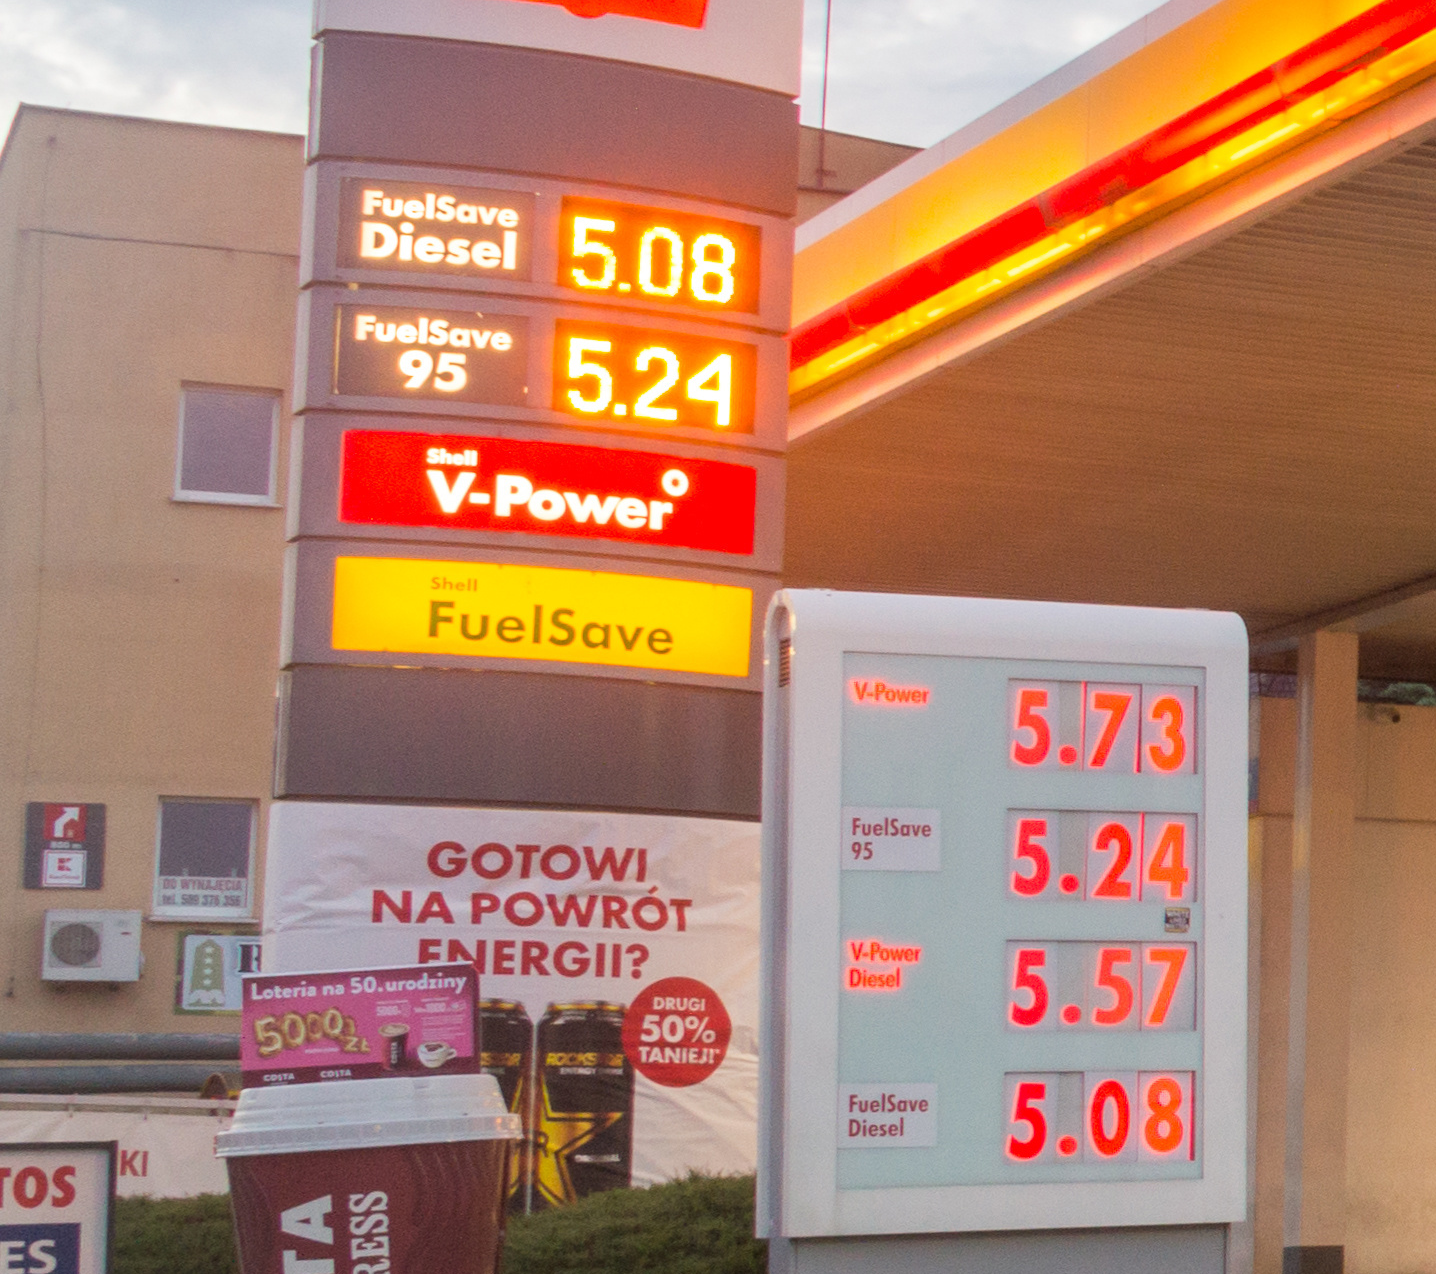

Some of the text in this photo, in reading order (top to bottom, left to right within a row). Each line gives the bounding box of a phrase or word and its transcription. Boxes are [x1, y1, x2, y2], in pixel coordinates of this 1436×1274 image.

[361, 188, 519, 229] FuelSave
[359, 222, 517, 270] Diesel
[570, 216, 736, 304] 5.08
[354, 314, 513, 353] FuelSave
[398, 351, 467, 393] 95
[567, 336, 733, 426] 5.24
[426, 447, 478, 467] Shell
[426, 469, 674, 531] V-Power
[430, 576, 479, 594] Shell
[428, 600, 674, 655] FuelSave
[851, 680, 930, 706] V-Power
[1010, 689, 1187, 772] 5.73
[851, 816, 931, 839] FuelSave
[427, 840, 647, 883] GOTOWI
[851, 841, 873, 861] 95
[1011, 819, 1189, 899] 5.24
[371, 886, 692, 933] NA POWRÓT
[418, 938, 650, 980] ENERGII?
[850, 942, 922, 964] V-Power
[251, 981, 317, 1000] Loteria
[323, 985, 344, 996] na
[385, 972, 467, 994] urodziny
[848, 968, 901, 990] Diesel
[1010, 949, 1187, 1027] 5.57
[653, 996, 706, 1011] DRUGI
[640, 1015, 717, 1044] 50%
[263, 1073, 295, 1081] COSTA
[321, 1069, 351, 1077] COSTA
[848, 1094, 929, 1115] FuelSave
[1006, 1079, 1183, 1160] 5.08
[848, 1118, 905, 1139] Diesel
